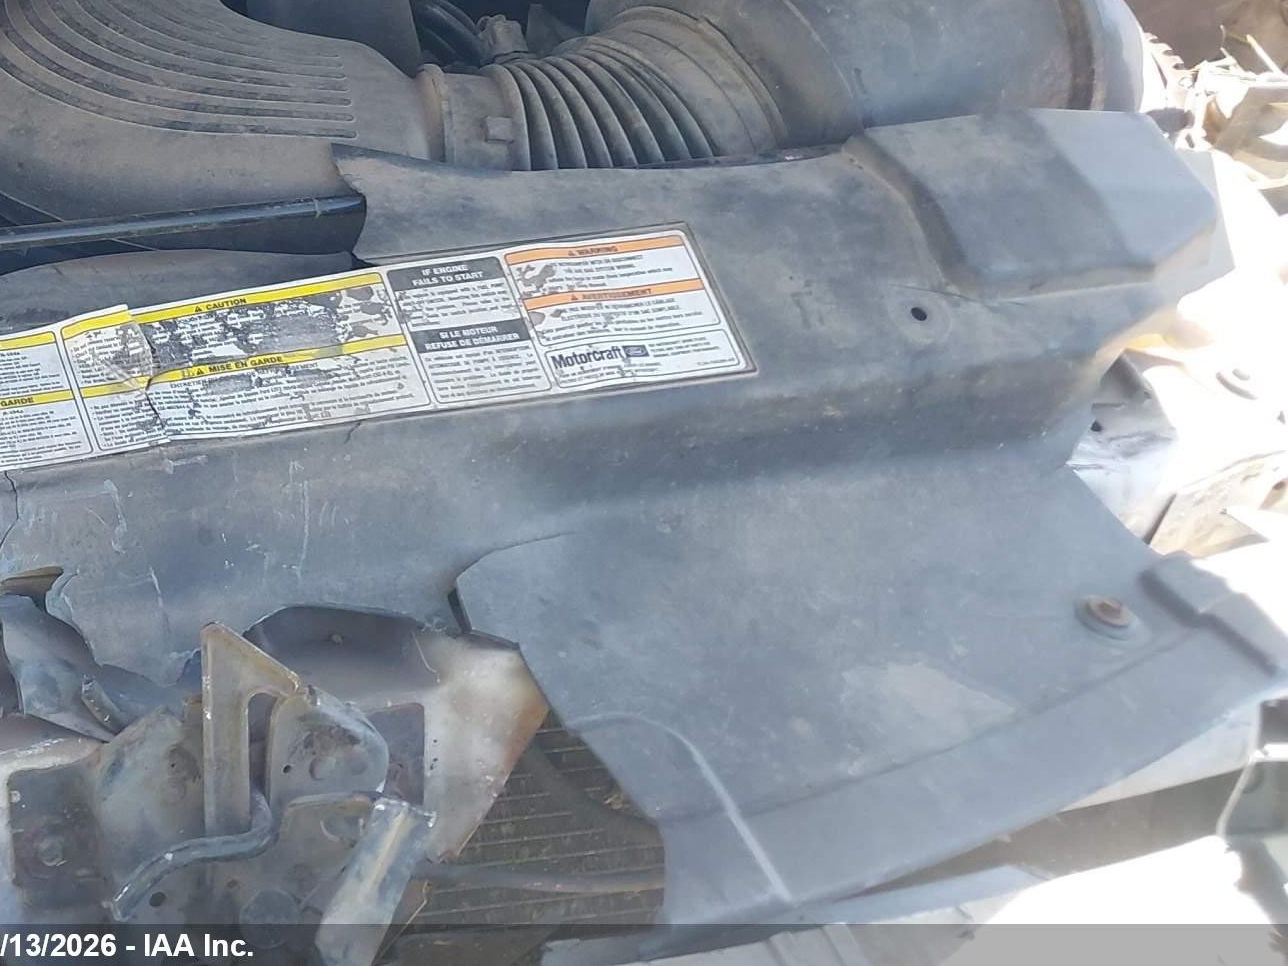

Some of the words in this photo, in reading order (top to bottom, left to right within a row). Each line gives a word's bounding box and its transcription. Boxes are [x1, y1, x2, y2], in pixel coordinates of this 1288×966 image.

[576, 246, 619, 257] WARNING
[432, 264, 469, 275] ENGINE
[412, 277, 438, 286] FAILS
[439, 275, 453, 283] TO
[454, 271, 483, 281] START
[206, 298, 247, 310] CAUTION
[449, 330, 461, 338] LE
[462, 326, 498, 336] MOTEUR
[424, 340, 458, 351] REFUSE
[459, 338, 472, 347] DE
[550, 345, 624, 370] Motorcraft
[208, 364, 232, 373] MISE
[235, 361, 248, 370] EN
[250, 356, 283, 367] GARDE
[0, 396, 34, 407] GARDE
